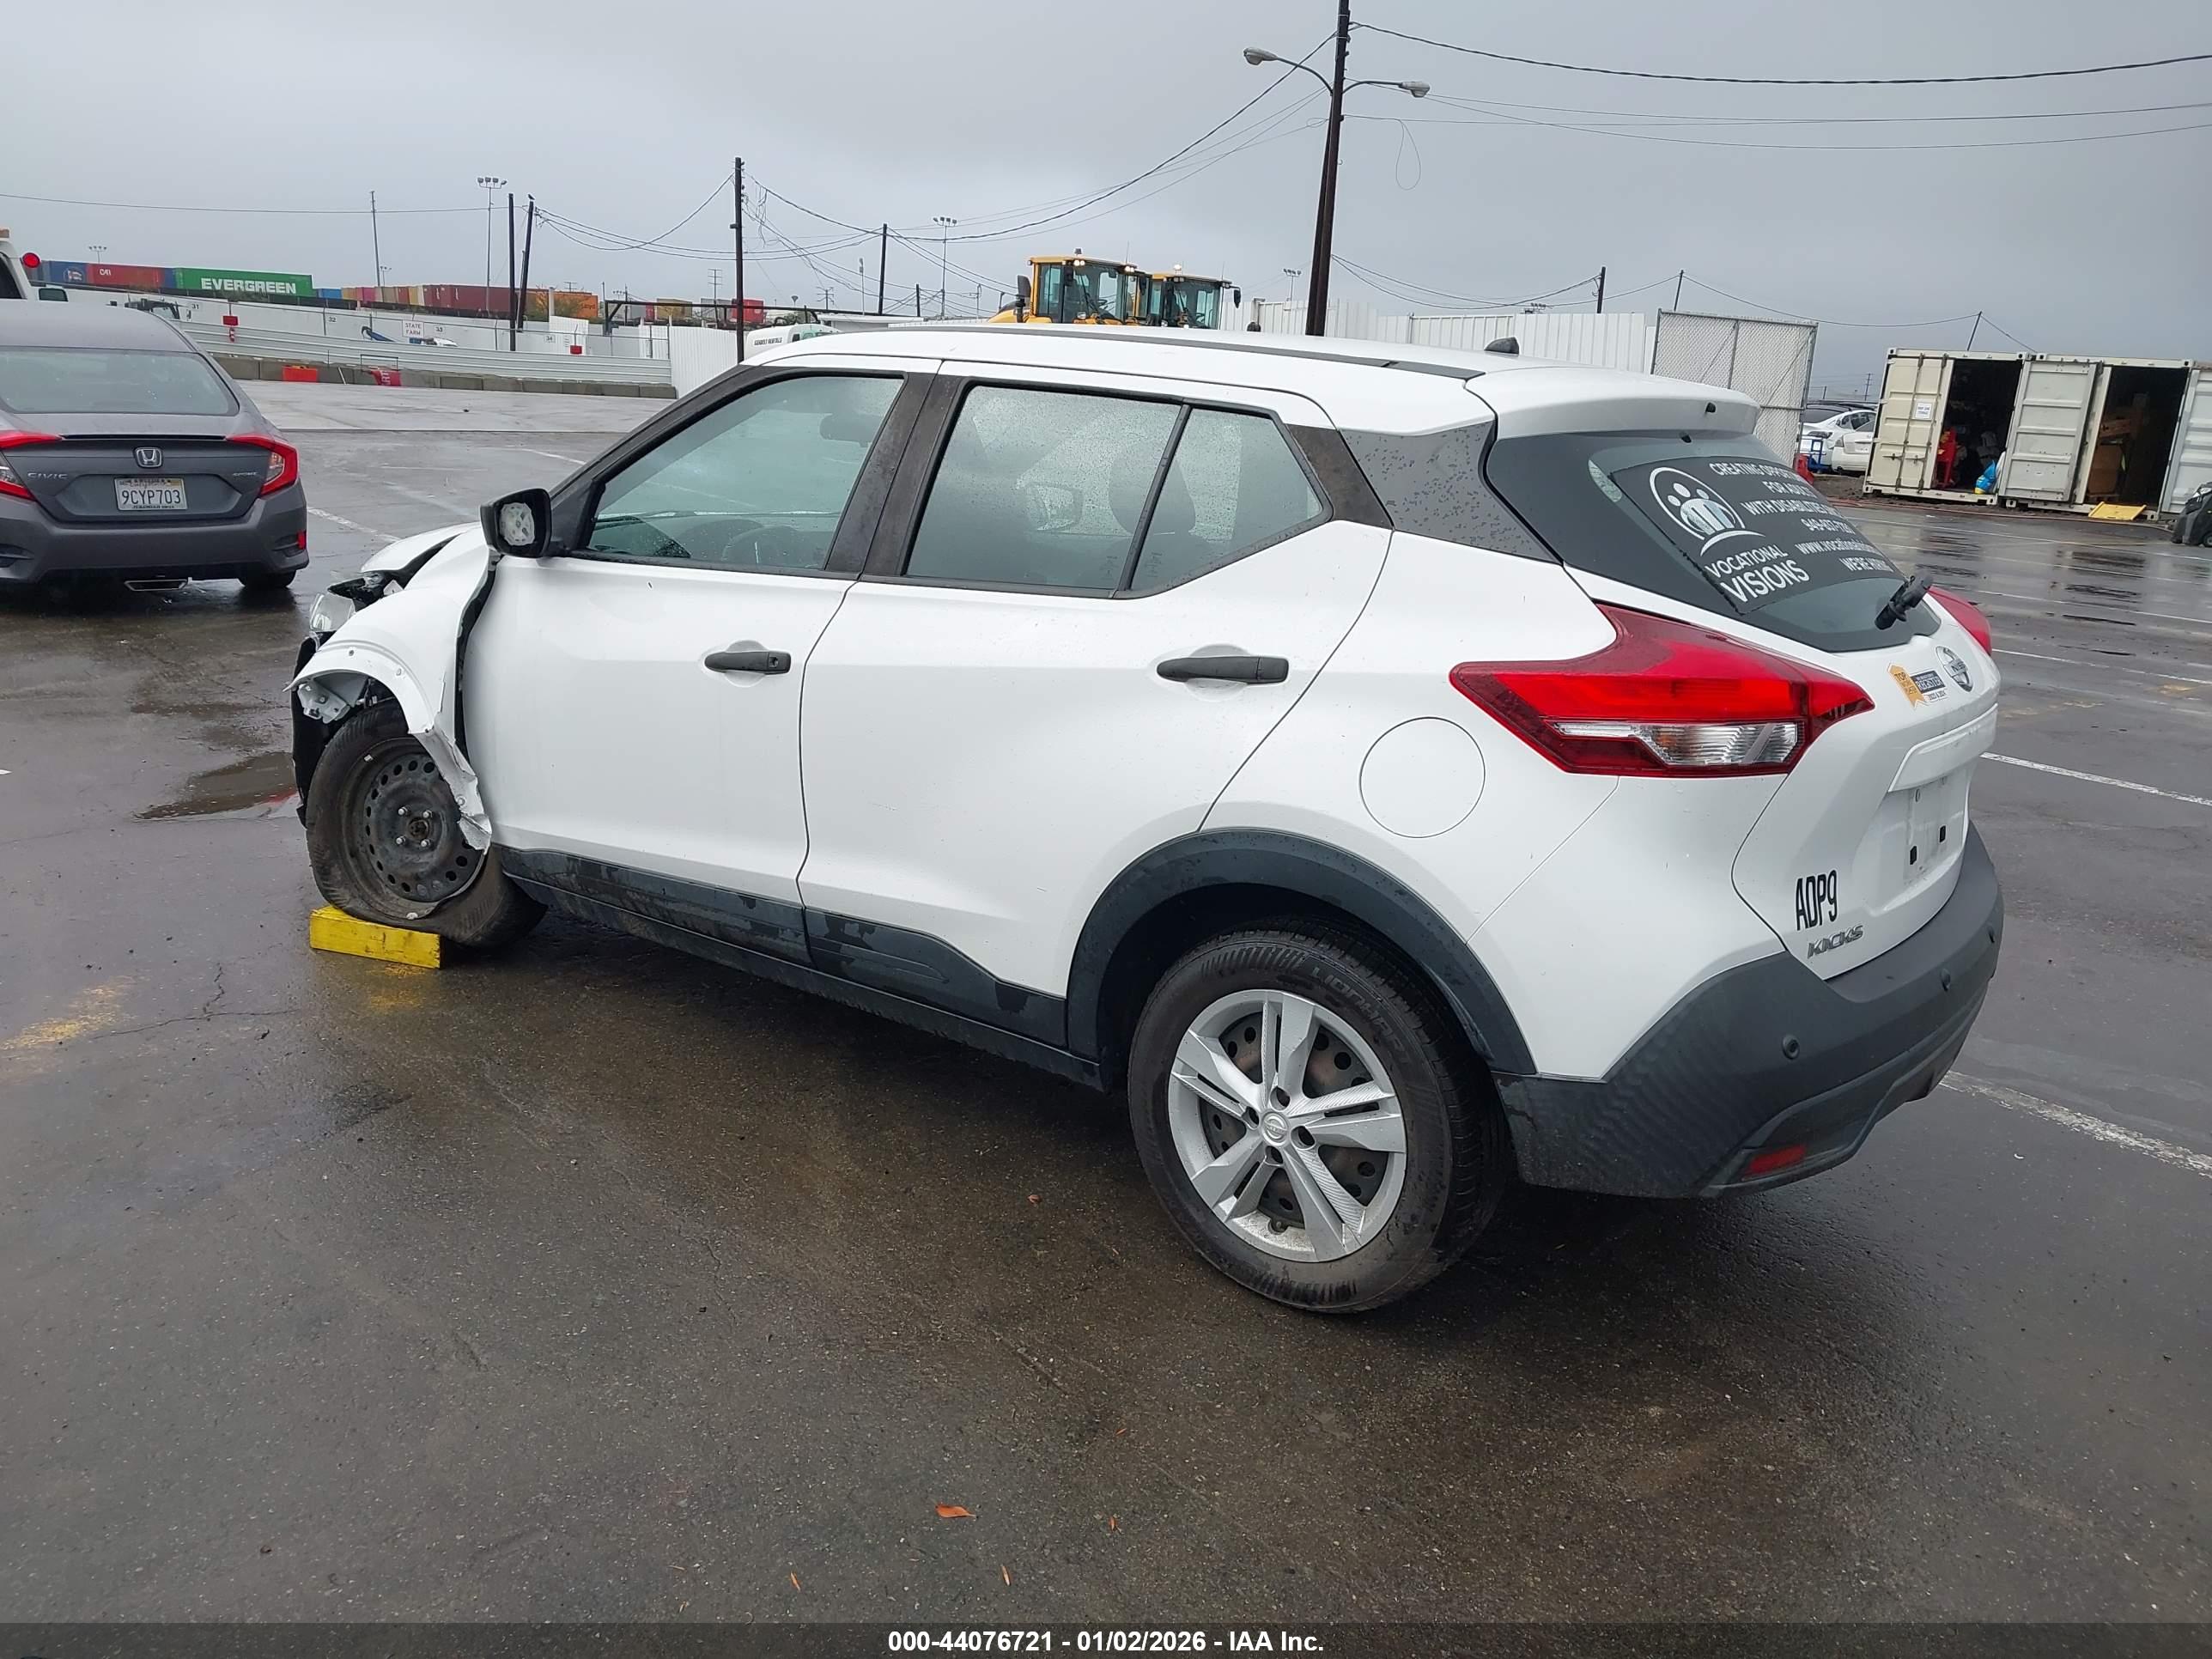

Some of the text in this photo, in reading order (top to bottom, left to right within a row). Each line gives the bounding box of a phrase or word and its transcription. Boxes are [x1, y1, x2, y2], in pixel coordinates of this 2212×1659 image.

[200, 277, 297, 295] EVERGREEN
[1709, 463, 1765, 477] CREATING
[1761, 481, 1784, 494] FOR
[121, 489, 181, 505] 9CYP703
[1740, 500, 1778, 516] WITH
[1705, 544, 1790, 578] VOCATIONAL
[1720, 559, 1810, 603] VISIONS
[1795, 869, 1838, 932] ADP9
[1807, 925, 1864, 959] KICKS
